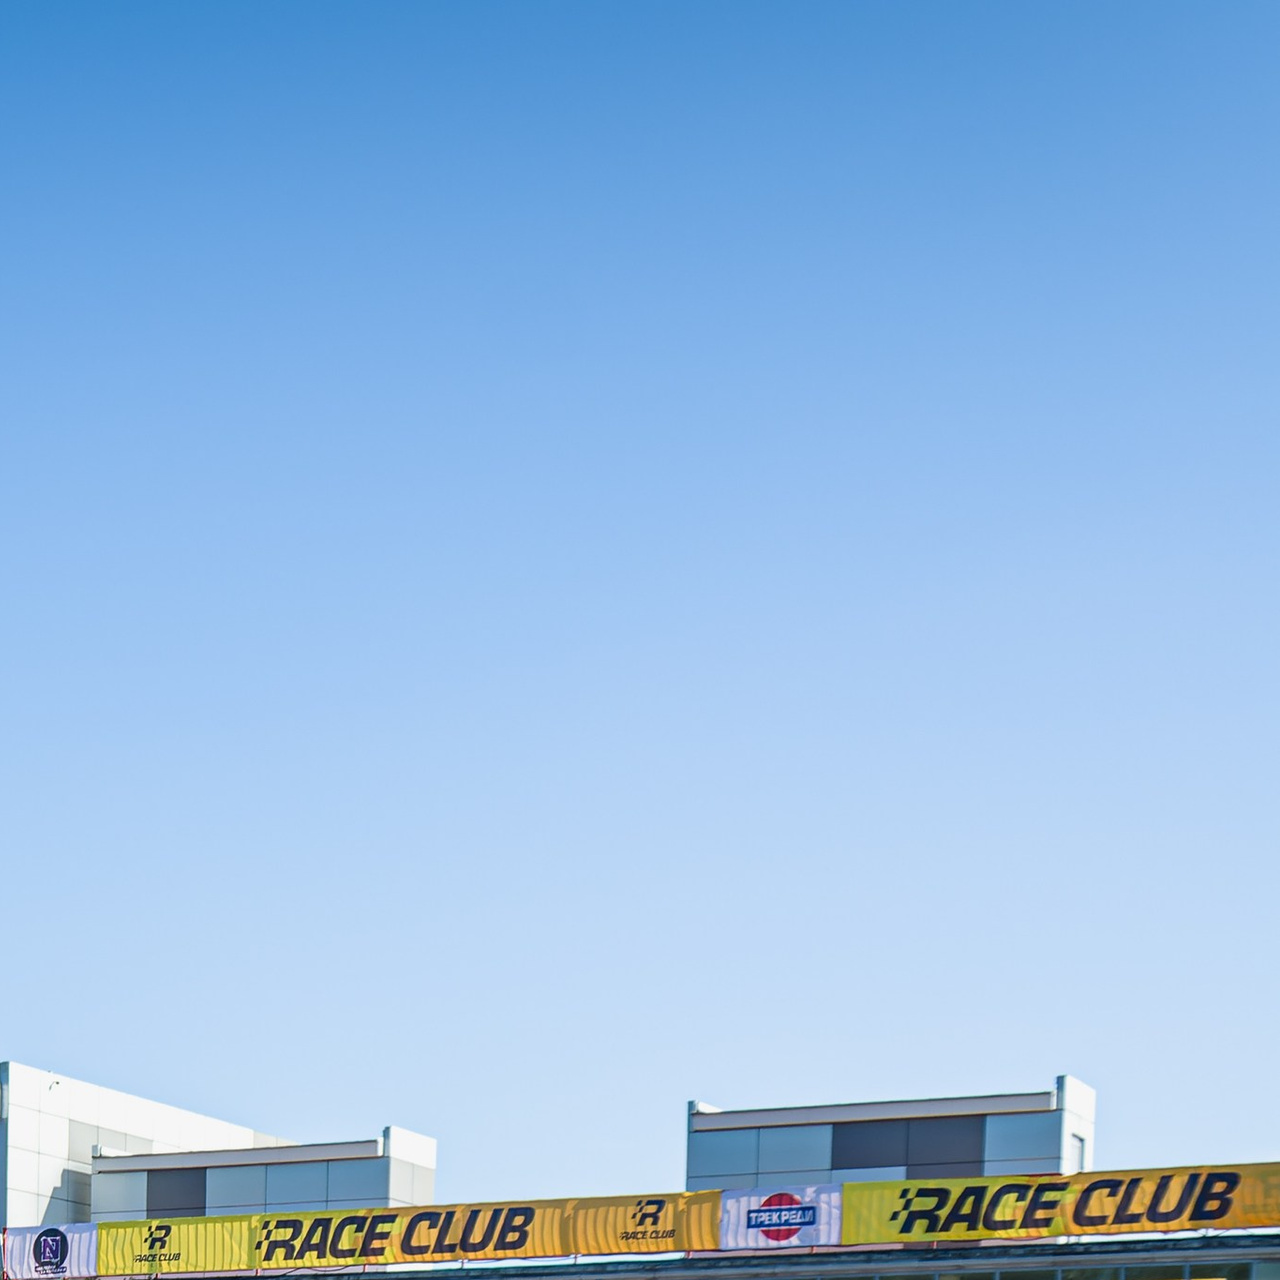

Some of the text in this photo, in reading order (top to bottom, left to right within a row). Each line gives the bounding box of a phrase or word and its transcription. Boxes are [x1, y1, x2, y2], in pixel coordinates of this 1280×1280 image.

[890, 1172, 1242, 1234] RACE CLUB
[255, 1206, 536, 1261] RACE CLUB
[620, 1229, 676, 1241] RACE CLUB
[133, 1252, 181, 1263] RACE CLUB
